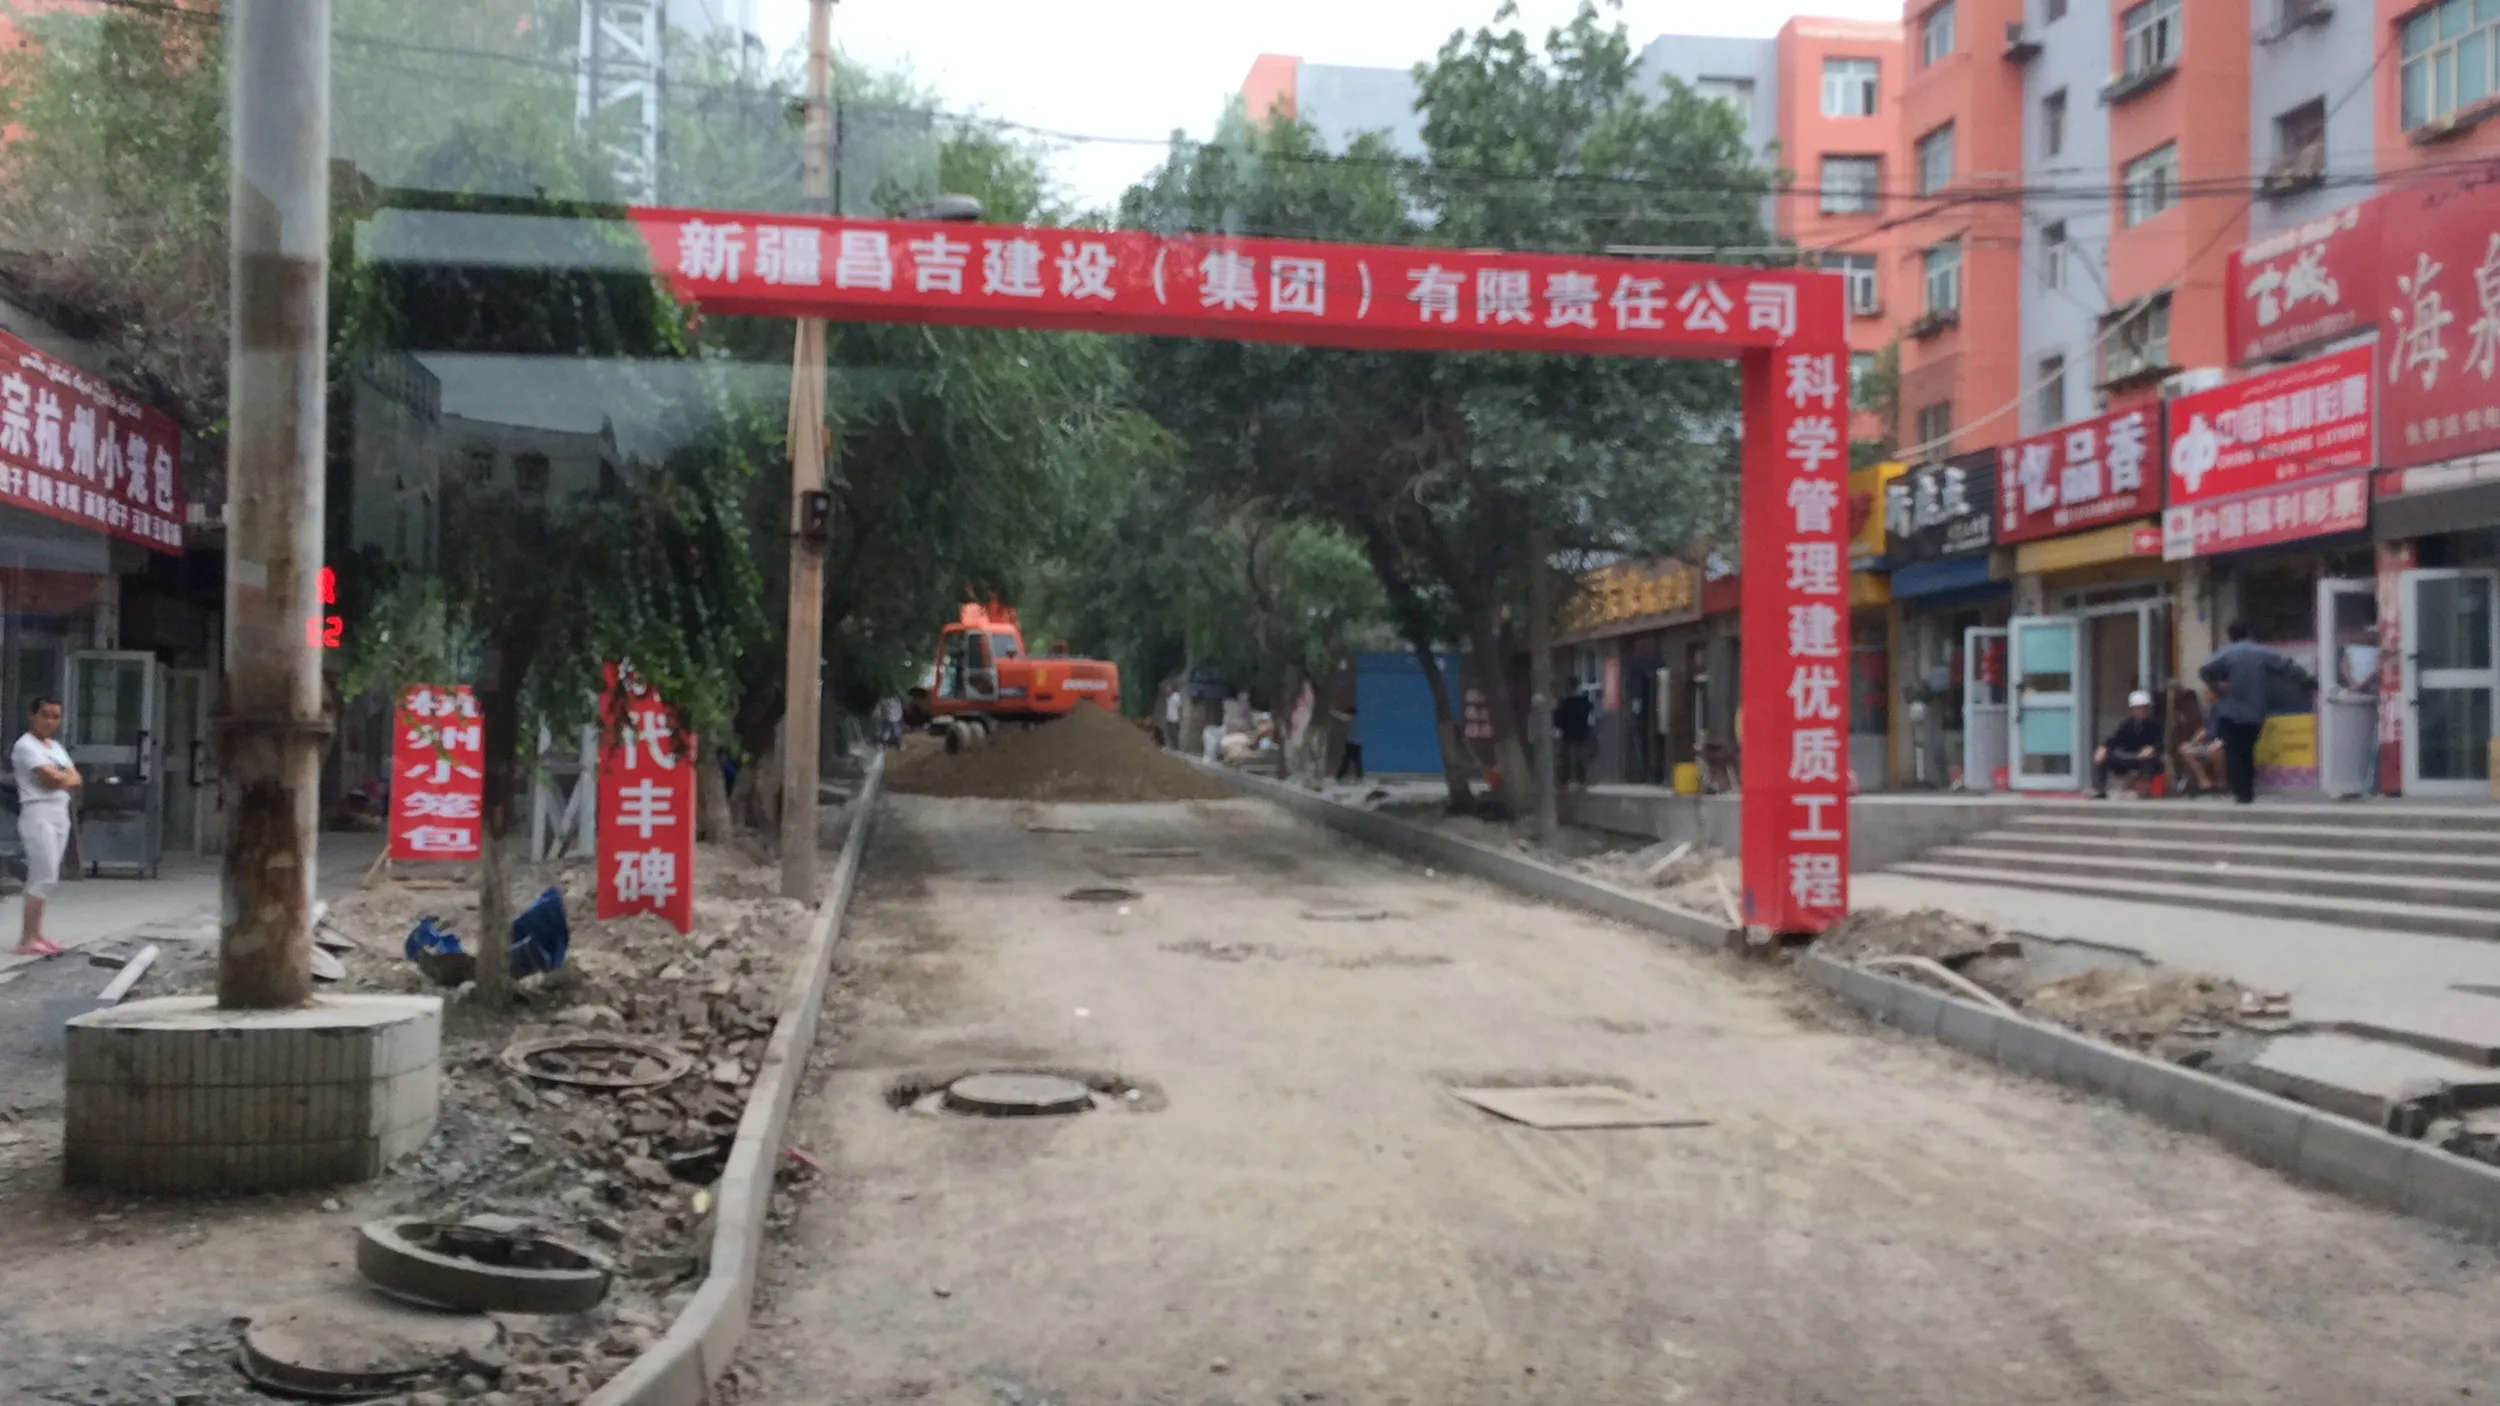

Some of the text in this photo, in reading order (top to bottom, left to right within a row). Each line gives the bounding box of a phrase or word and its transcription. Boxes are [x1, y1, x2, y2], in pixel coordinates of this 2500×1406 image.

[1785, 353, 1842, 908] 科学管理建优质工程
[400, 689, 482, 852] 杭州小笼包
[614, 658, 678, 908] 代丰碑
